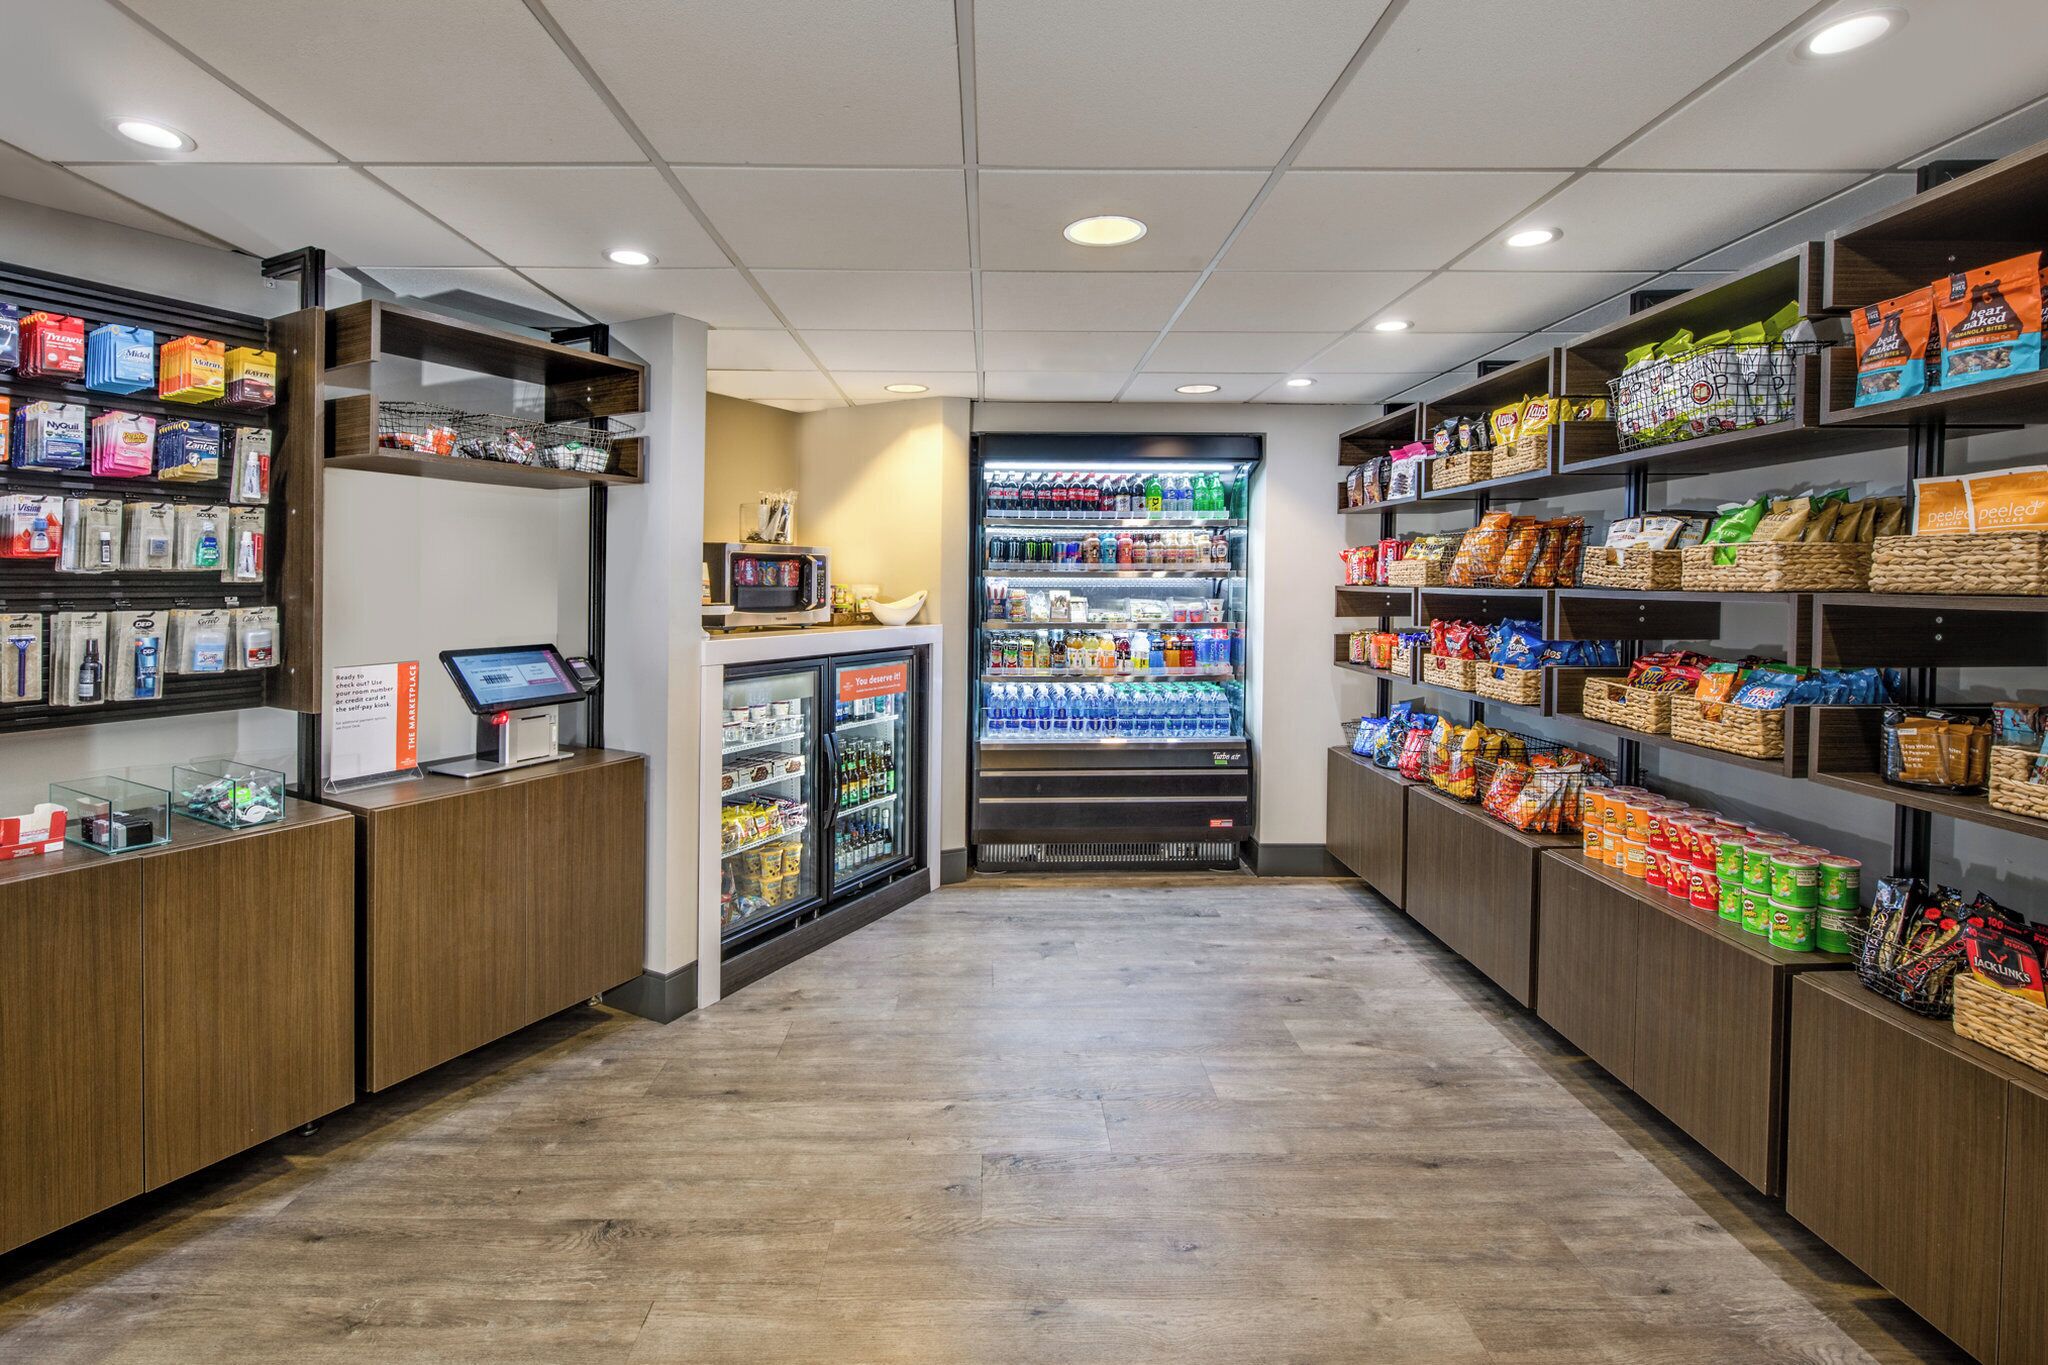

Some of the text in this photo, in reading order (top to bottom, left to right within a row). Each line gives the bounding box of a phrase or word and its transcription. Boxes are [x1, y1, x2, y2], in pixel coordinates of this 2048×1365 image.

[1970, 306, 2004, 320] bear
[1961, 312, 2007, 332] naked
[1954, 324, 2008, 338] GRANOLA BITES
[46, 332, 84, 344] TYLENOL
[1876, 333, 1898, 347] bear
[1869, 340, 1900, 356] naked
[125, 349, 151, 360] Midol
[193, 358, 221, 370] Motrin
[245, 369, 271, 379] BAYER
[1527, 404, 1549, 420] Lay's
[46, 421, 80, 431] NyQuil
[185, 440, 218, 450] Zantac
[17, 503, 43, 512] Visine
[1978, 501, 2039, 524] peeled
[1988, 516, 2024, 525] SNACKS
[134, 620, 152, 628] DEP
[197, 616, 220, 625] Secret
[335, 681, 357, 689] check
[356, 680, 370, 688] out?
[856, 677, 869, 687] You
[868, 674, 893, 685] deserve
[893, 671, 901, 680] it!
[344, 696, 364, 704] credit
[408, 664, 417, 730] MARKETPLACE
[408, 732, 416, 749] THE
[1212, 751, 1230, 760] Turbo
[1987, 916, 2004, 929] 100
[1973, 956, 2032, 984] JACK LINK'S
